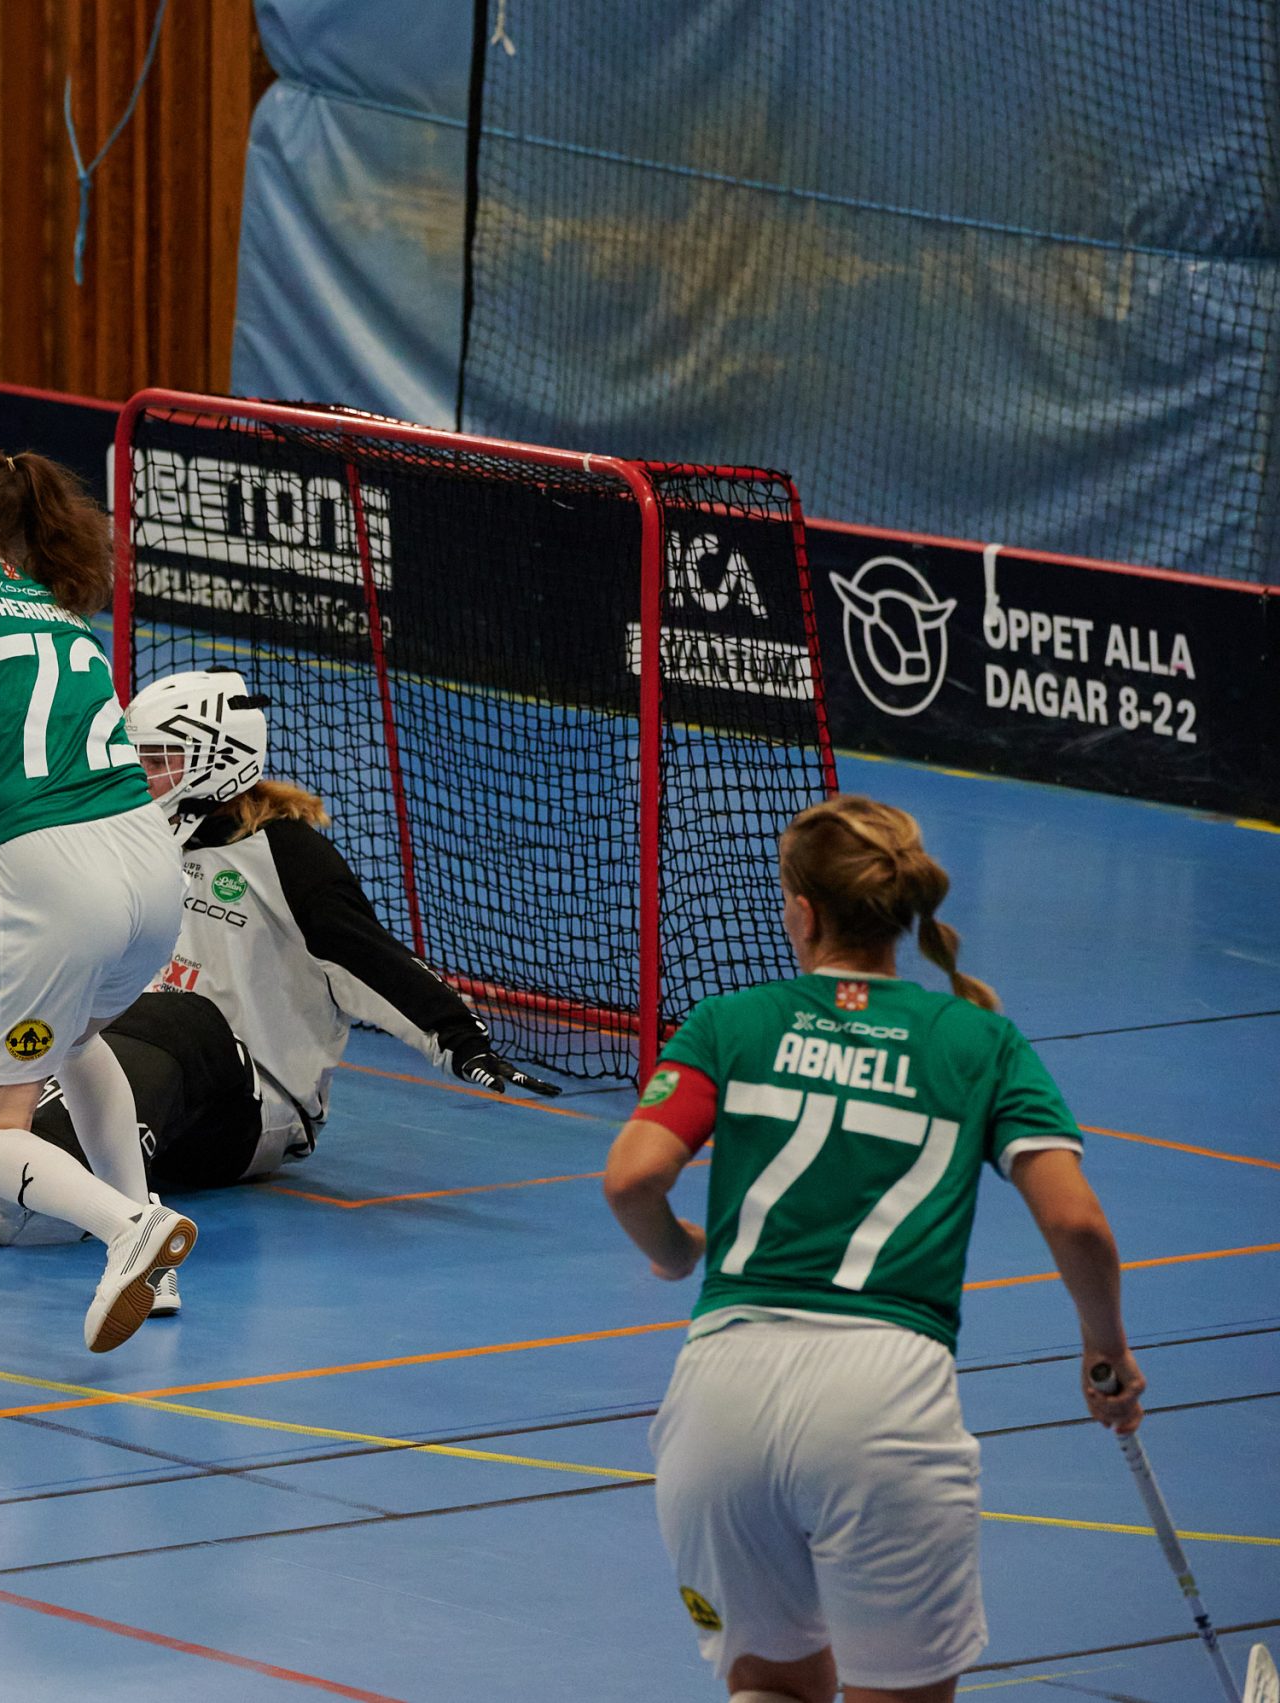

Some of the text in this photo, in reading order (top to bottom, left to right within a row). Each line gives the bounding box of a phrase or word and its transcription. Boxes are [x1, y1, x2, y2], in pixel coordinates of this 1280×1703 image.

[668, 530, 768, 619] ICA
[1105, 624, 1196, 680] ALLA
[985, 664, 1197, 744] DAGAR 8-22
[773, 1032, 917, 1098] ABNELL
[721, 1080, 960, 1291] 77
